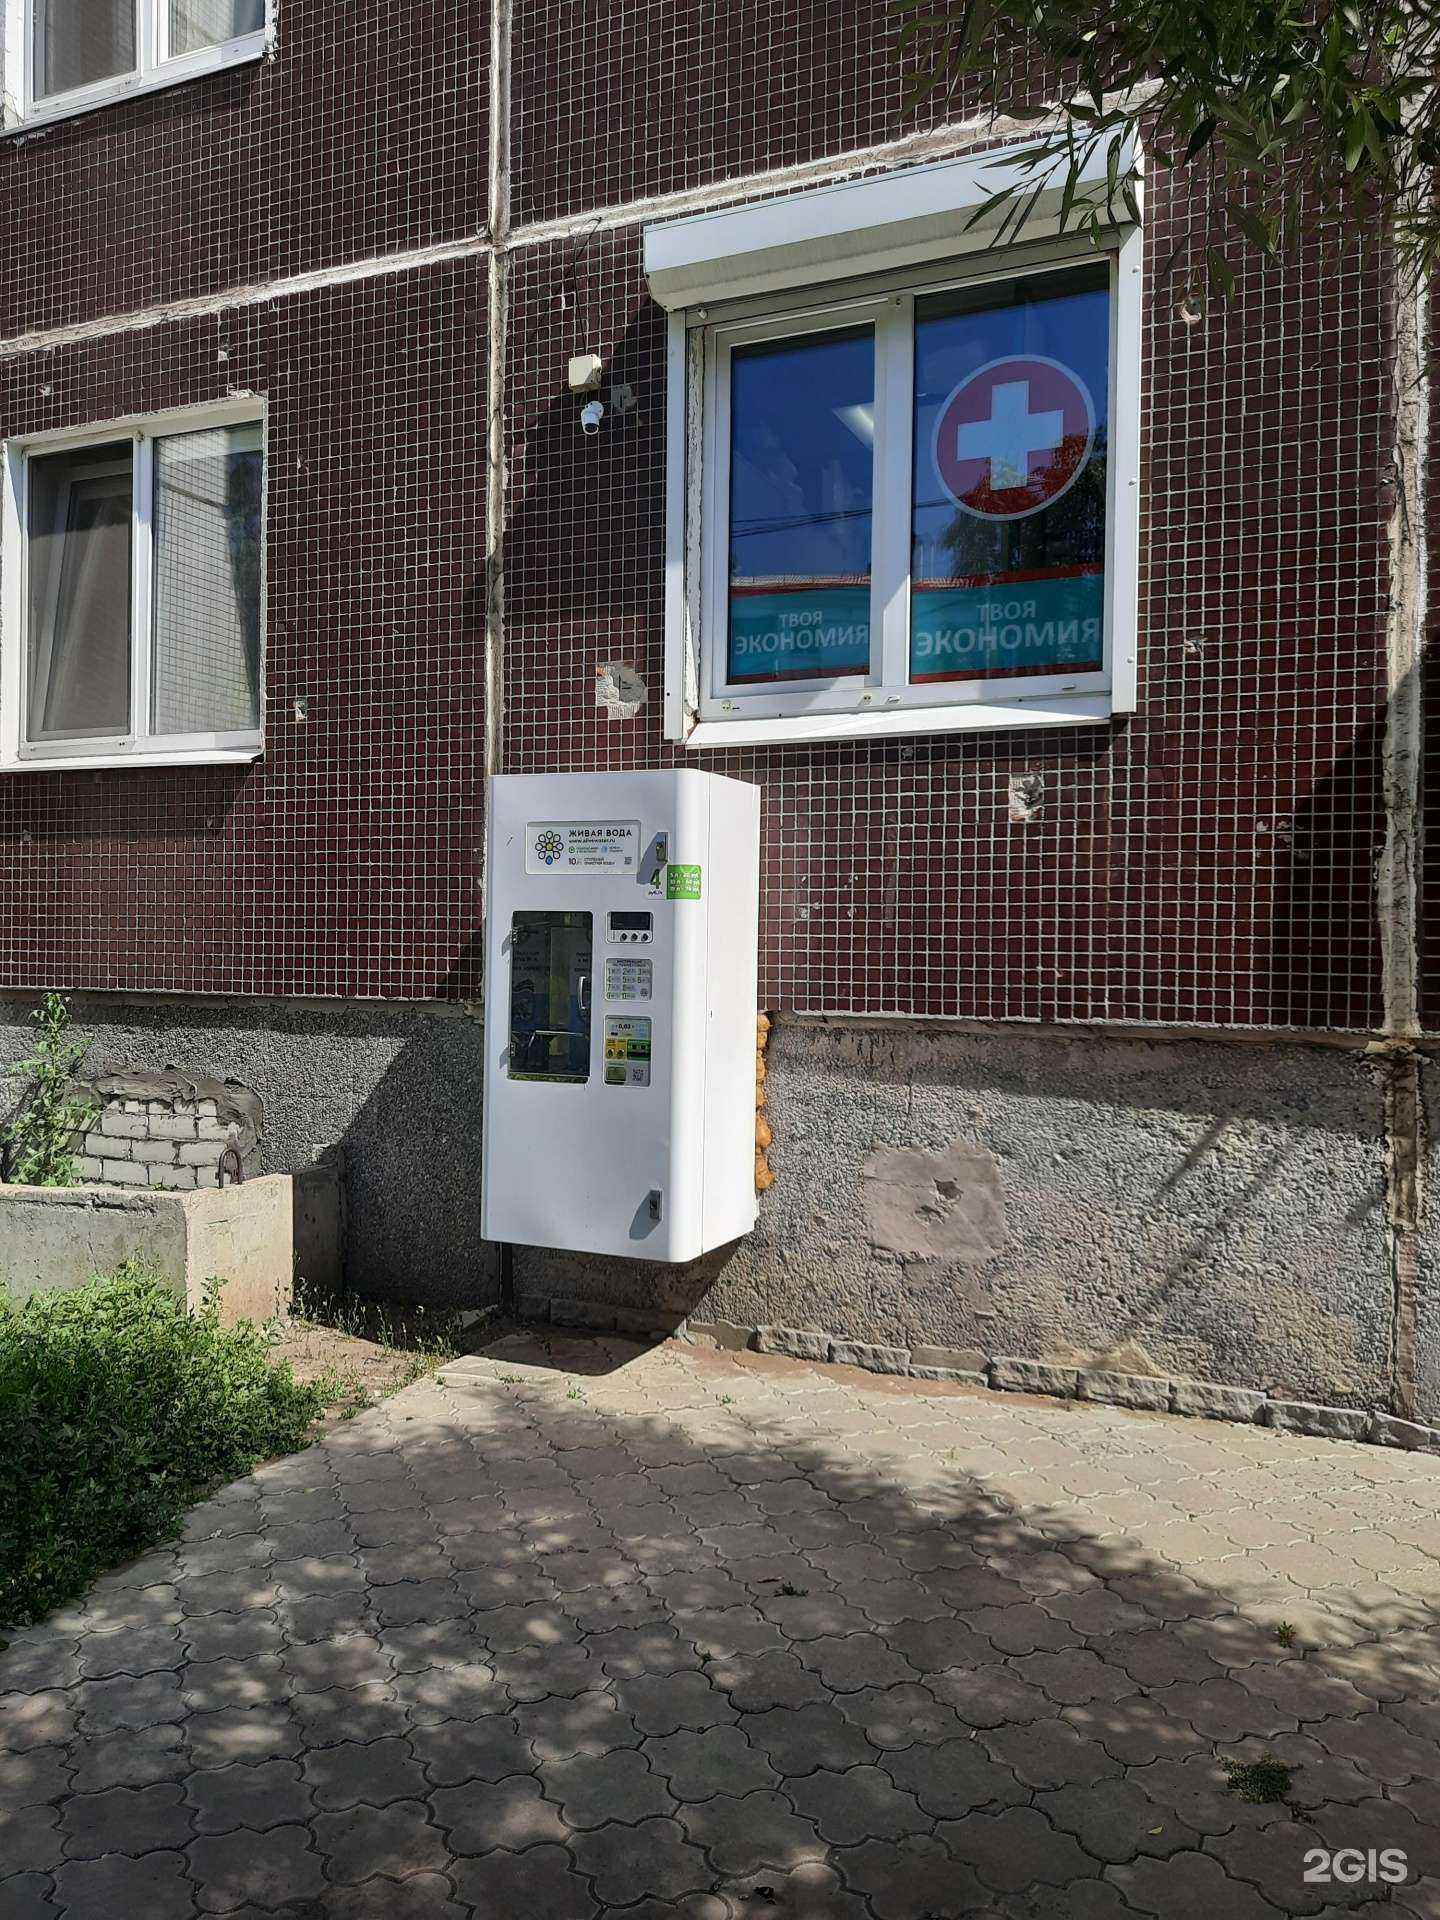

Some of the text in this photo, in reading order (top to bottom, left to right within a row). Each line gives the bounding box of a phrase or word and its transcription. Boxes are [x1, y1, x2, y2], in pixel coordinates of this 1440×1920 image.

[779, 610, 823, 628] ТВОЯ
[975, 600, 1036, 622] ТВОЯ
[735, 624, 869, 656] ЭКОНОМИЯ
[914, 617, 1100, 658] ЭКОНОМИЯ
[568, 829, 633, 838] ЖИВАЯ ВОДА
[650, 869, 661, 889] 4
